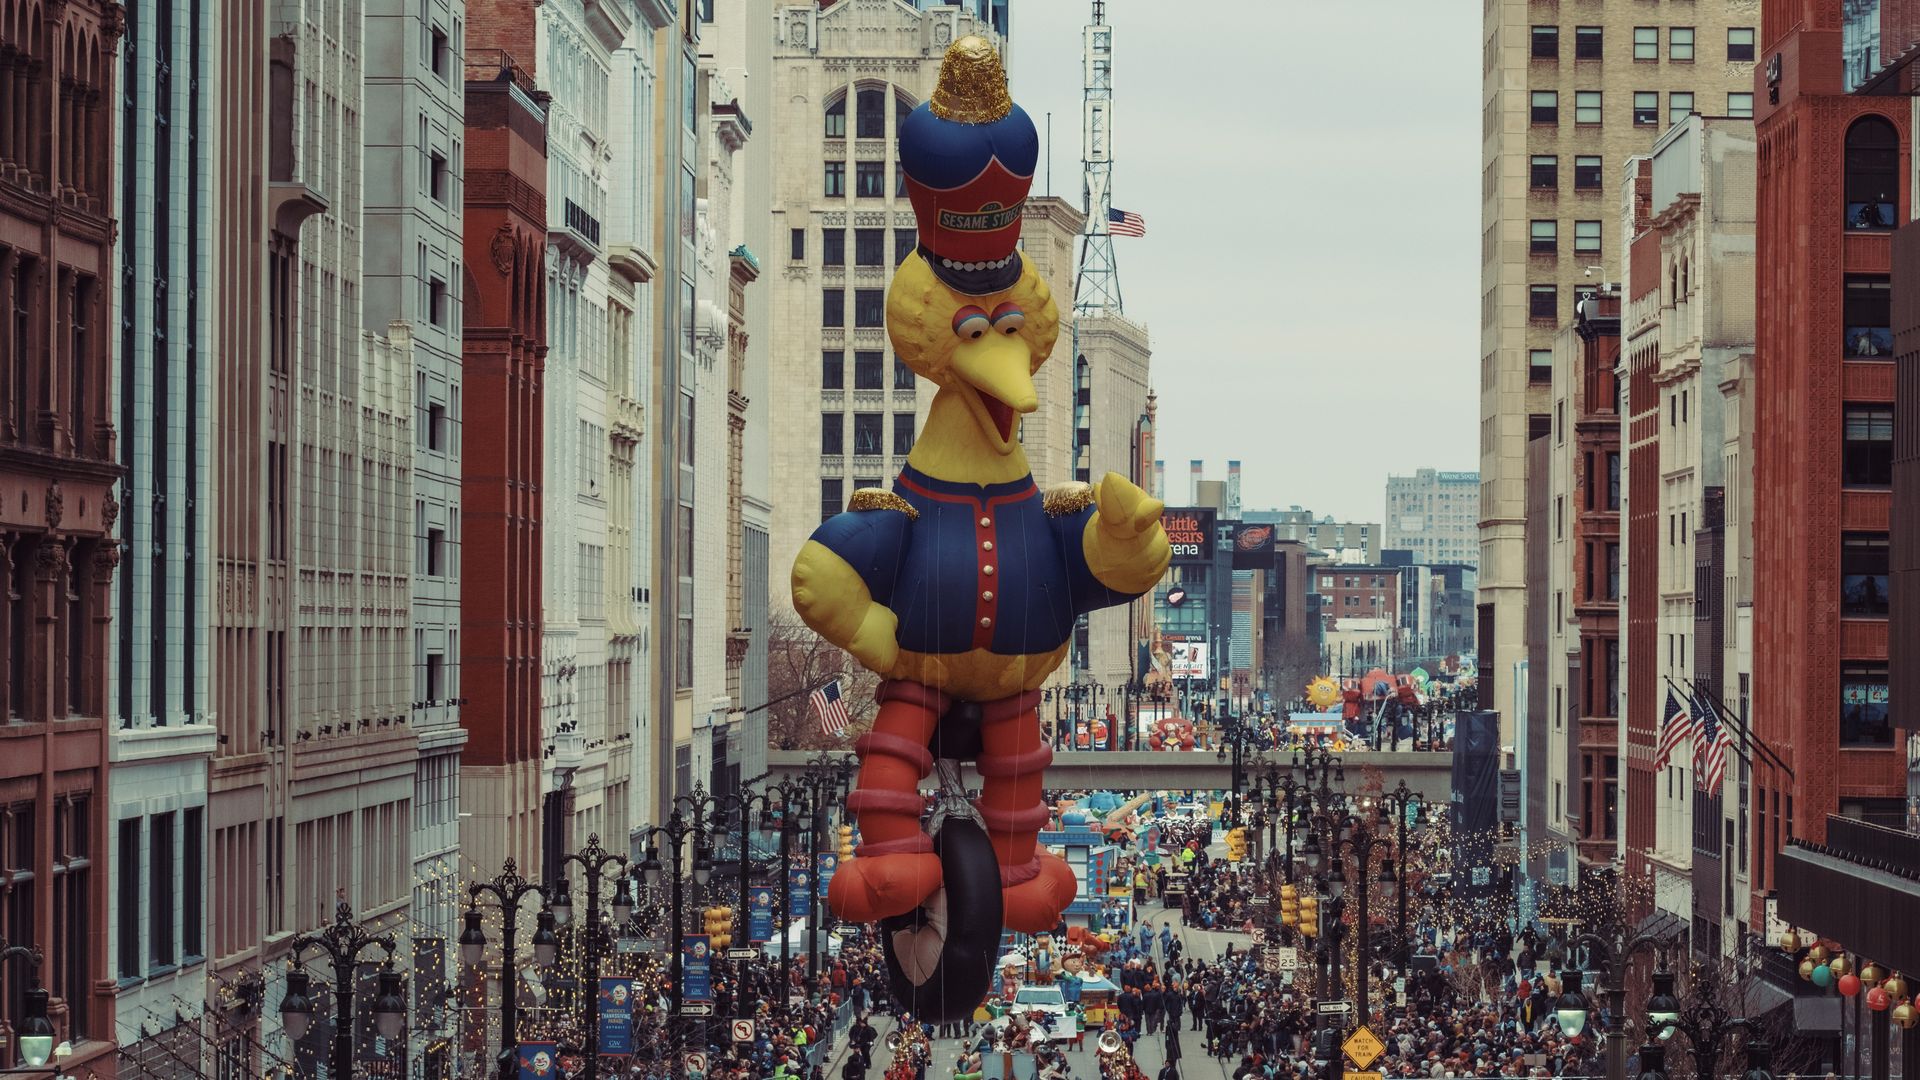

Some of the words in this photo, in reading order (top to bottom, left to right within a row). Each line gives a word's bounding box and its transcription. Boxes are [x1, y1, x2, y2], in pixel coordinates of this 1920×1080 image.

[943, 213, 989, 229] SESAME
[1162, 516, 1198, 531] Little
[1171, 544, 1198, 555] rena
[1281, 959, 1295, 967] 25
[375, 1034, 386, 1056] NIKE
